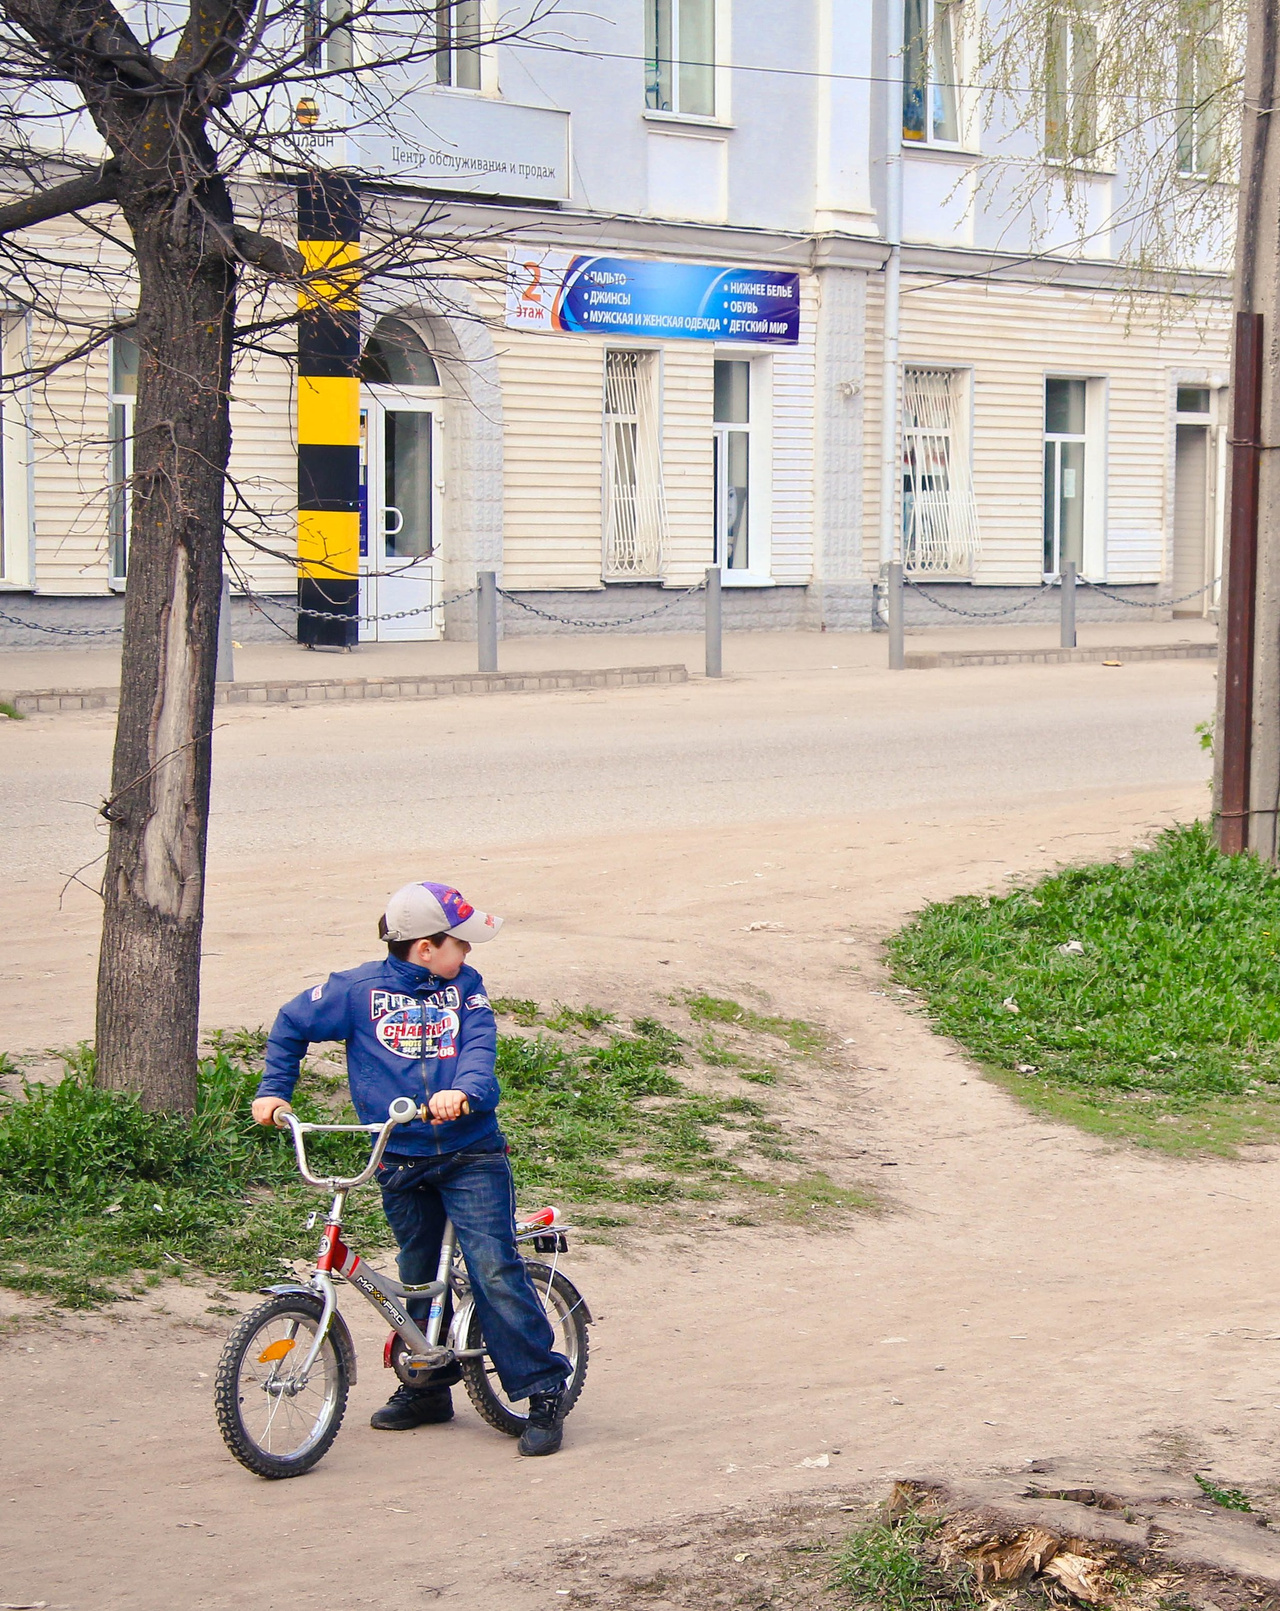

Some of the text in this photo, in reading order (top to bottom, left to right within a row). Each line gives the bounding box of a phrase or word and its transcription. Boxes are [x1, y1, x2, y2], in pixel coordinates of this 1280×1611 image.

[392, 146, 556, 179] Центр обслуживания и продаж
[522, 261, 541, 302] 2
[590, 271, 627, 285] ПАЛЬТО
[730, 282, 793, 298] НИЖНЕЕ БЕЛЬЕ
[589, 290, 631, 306] ДЖИНСЫ
[516, 306, 544, 319] этаж
[730, 301, 758, 314] ОБУВЬ
[589, 310, 720, 332] МУЖСКАЯ И ЖЕНСКАЯ ОДЕЖДА
[729, 319, 788, 334] ДЕТСКИЙ МИР
[439, 1046, 455, 1057] 08
